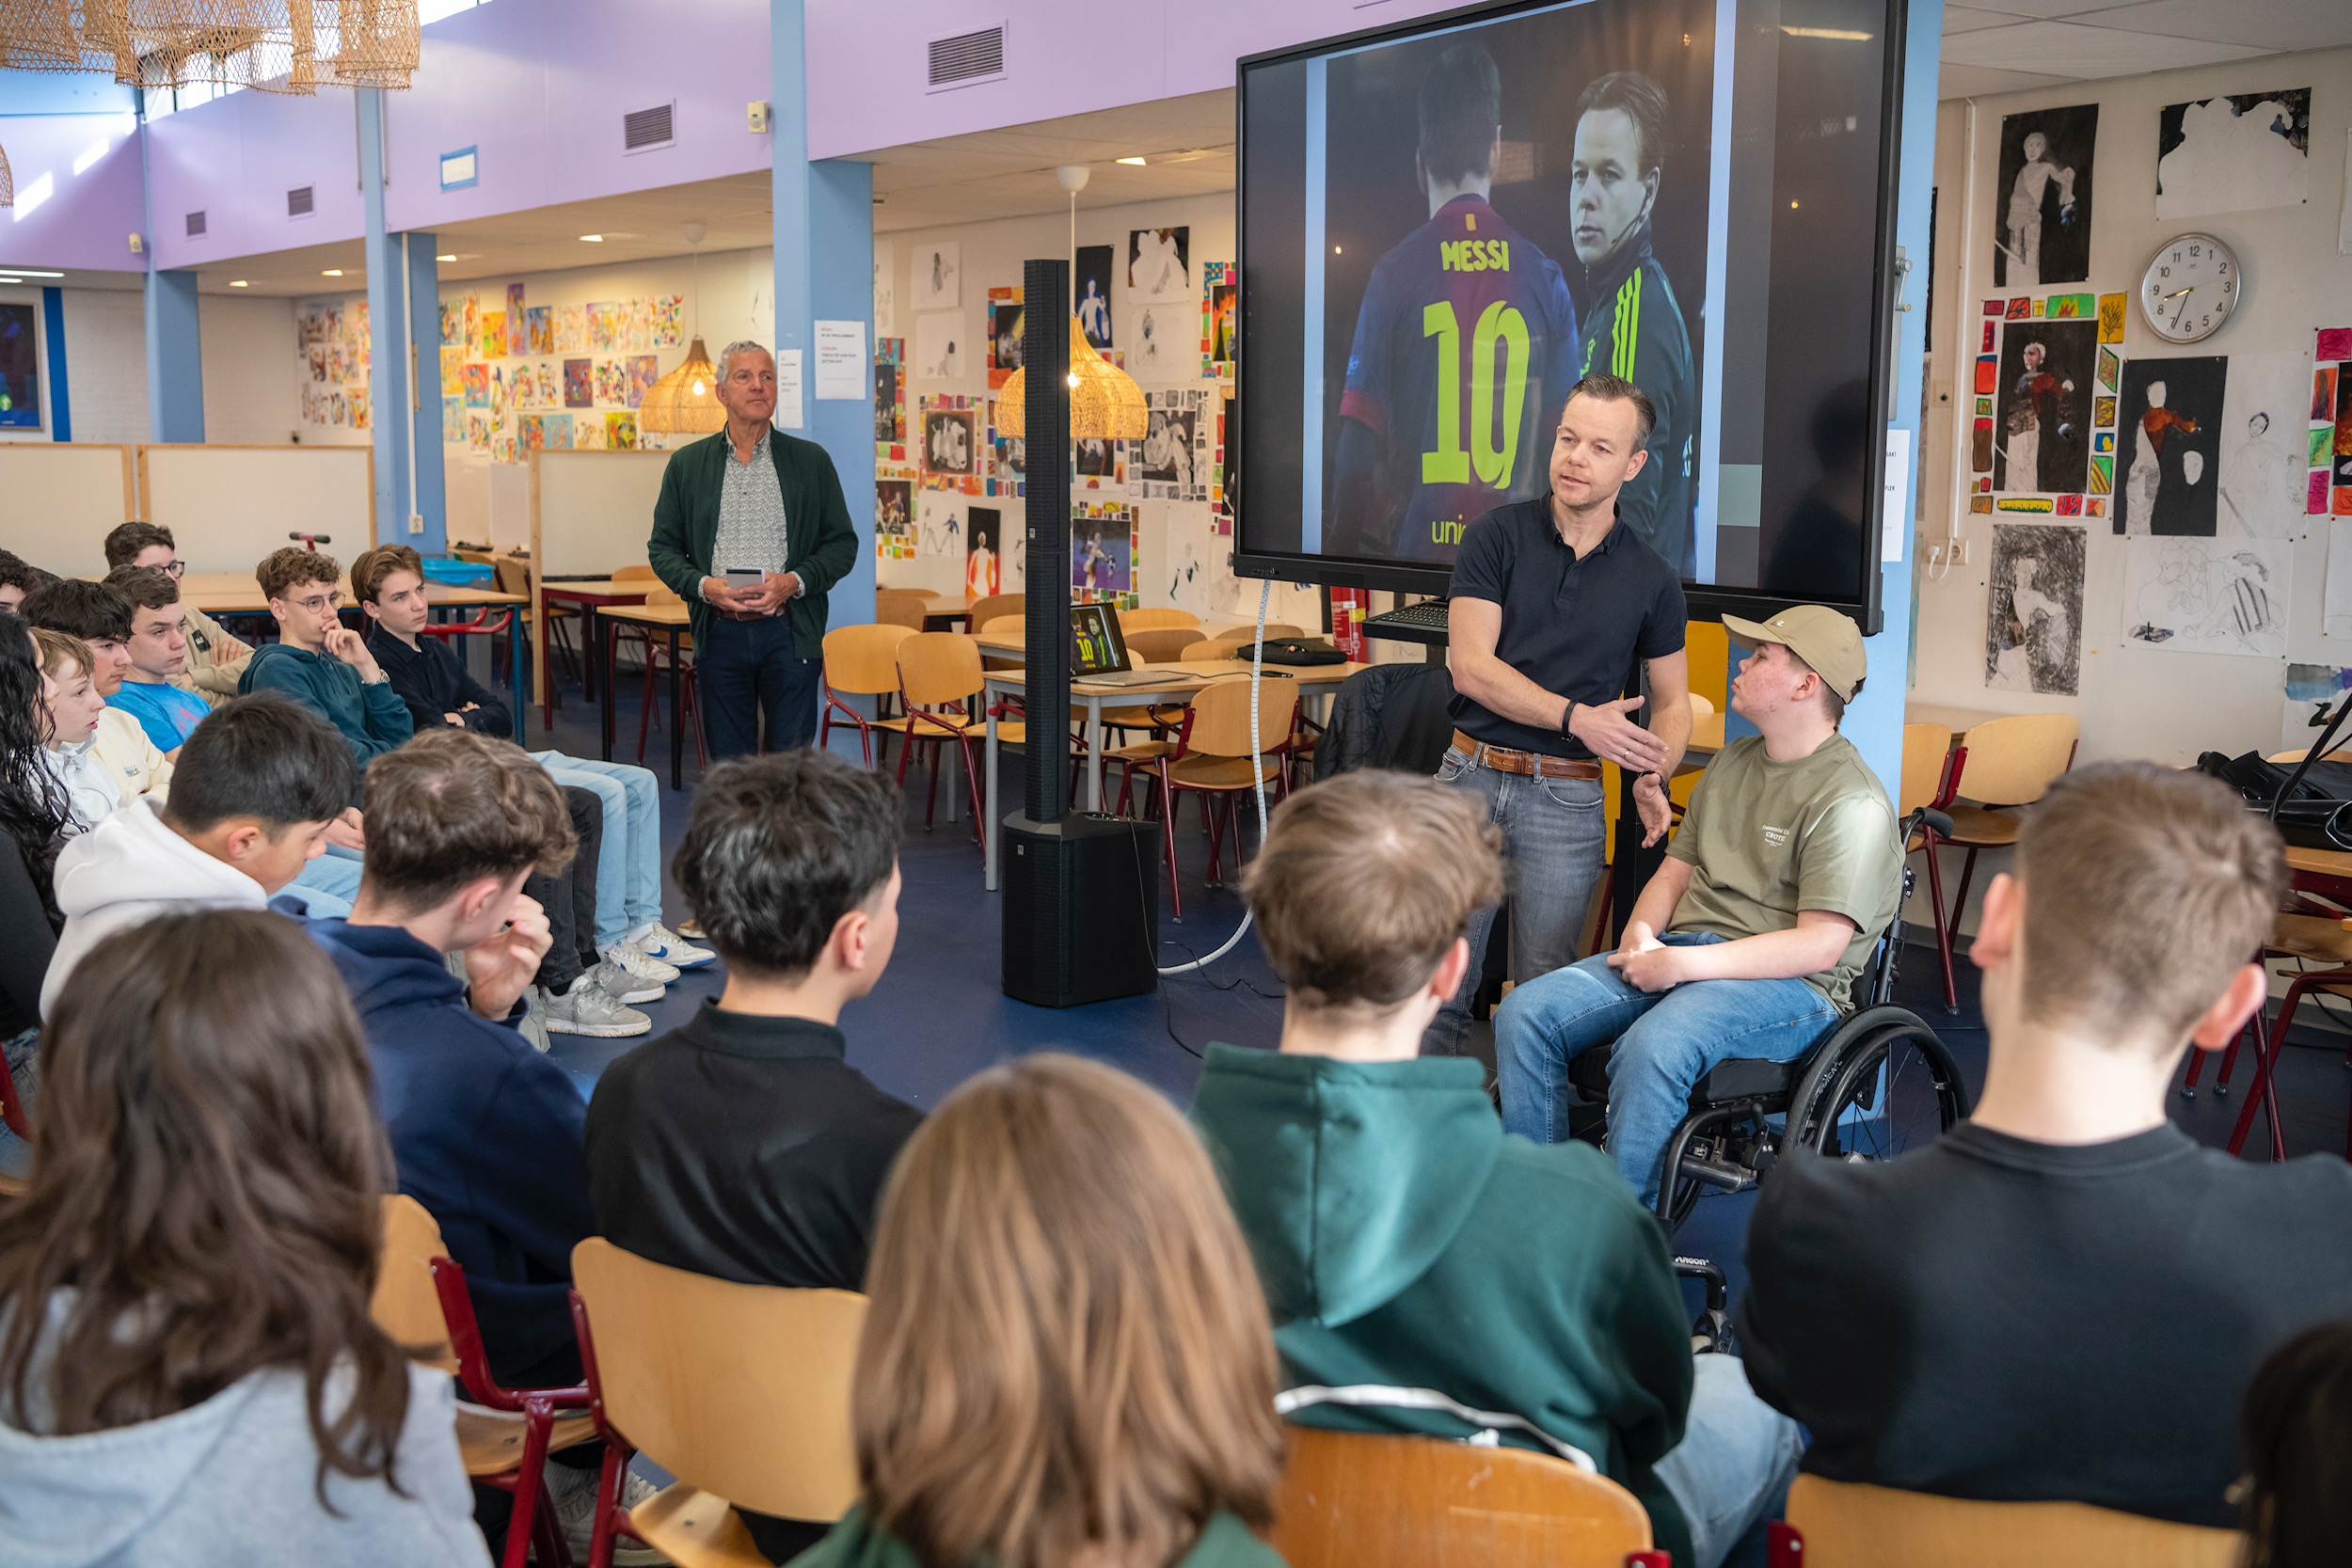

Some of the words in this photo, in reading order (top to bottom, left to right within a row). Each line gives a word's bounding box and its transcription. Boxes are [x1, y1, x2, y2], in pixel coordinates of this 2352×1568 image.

[1440, 239, 1510, 272] MESSI
[2189, 245, 2201, 257] 12
[2209, 249, 2214, 260] 1
[2173, 253, 2182, 263] 11
[2160, 266, 2170, 277] 10
[2219, 262, 2227, 274] 2
[2153, 285, 2160, 295] 9
[2224, 282, 2231, 293] 3
[2157, 305, 2164, 315] 8
[2216, 302, 2223, 312] 4
[2170, 317, 2176, 328] 7
[2202, 315, 2210, 326] 5
[2185, 321, 2192, 332] 6
[1422, 300, 1531, 489] 10
[1432, 514, 1467, 546] uni
[1076, 639, 1094, 661] 10
